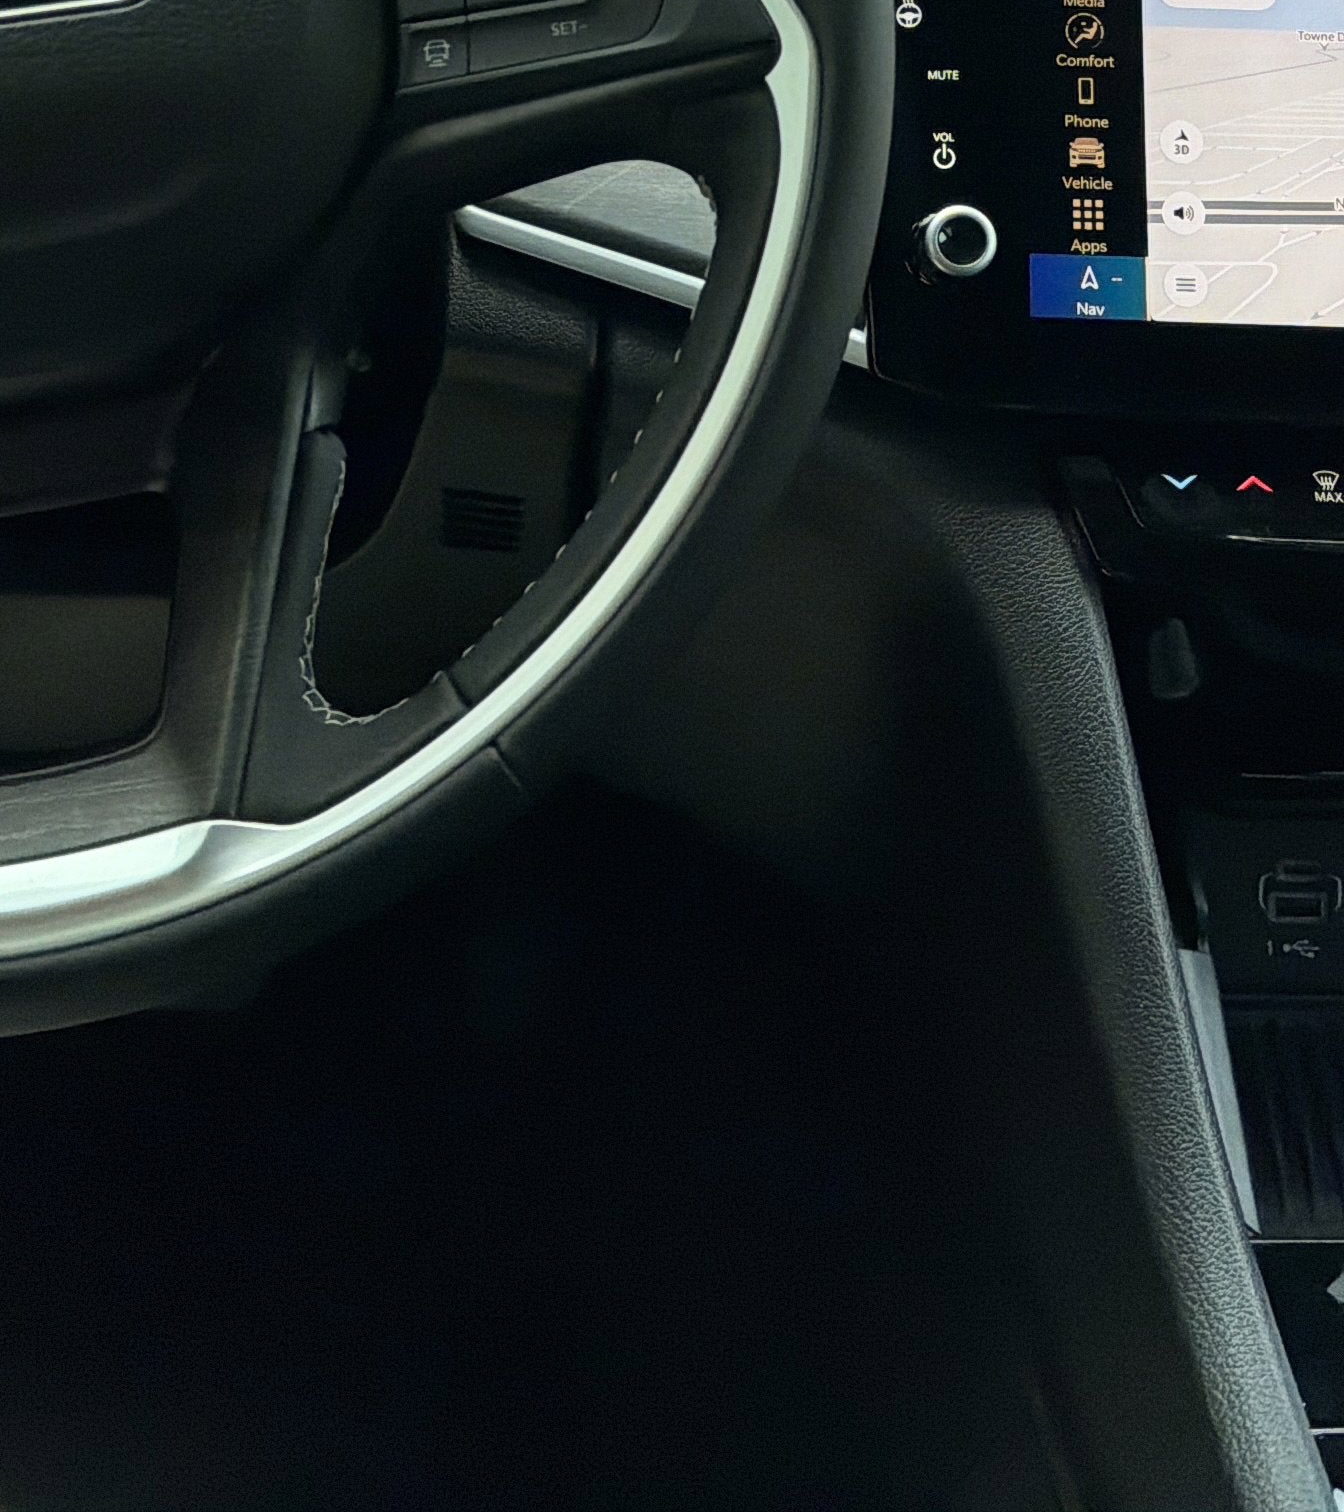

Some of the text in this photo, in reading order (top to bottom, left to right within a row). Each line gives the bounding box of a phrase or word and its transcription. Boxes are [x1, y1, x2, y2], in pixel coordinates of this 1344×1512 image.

[1298, 30, 1335, 42] Towne
[1055, 53, 1116, 69] Comfort
[927, 69, 960, 81] MUTE
[1064, 114, 1110, 129] Phone
[932, 132, 955, 143] VOL
[1173, 144, 1190, 156] 3D
[1061, 176, 1114, 191] Vehicle
[1070, 238, 1108, 256] Apps
[1076, 301, 1105, 317] Nav
[1314, 491, 1344, 504] MAX
